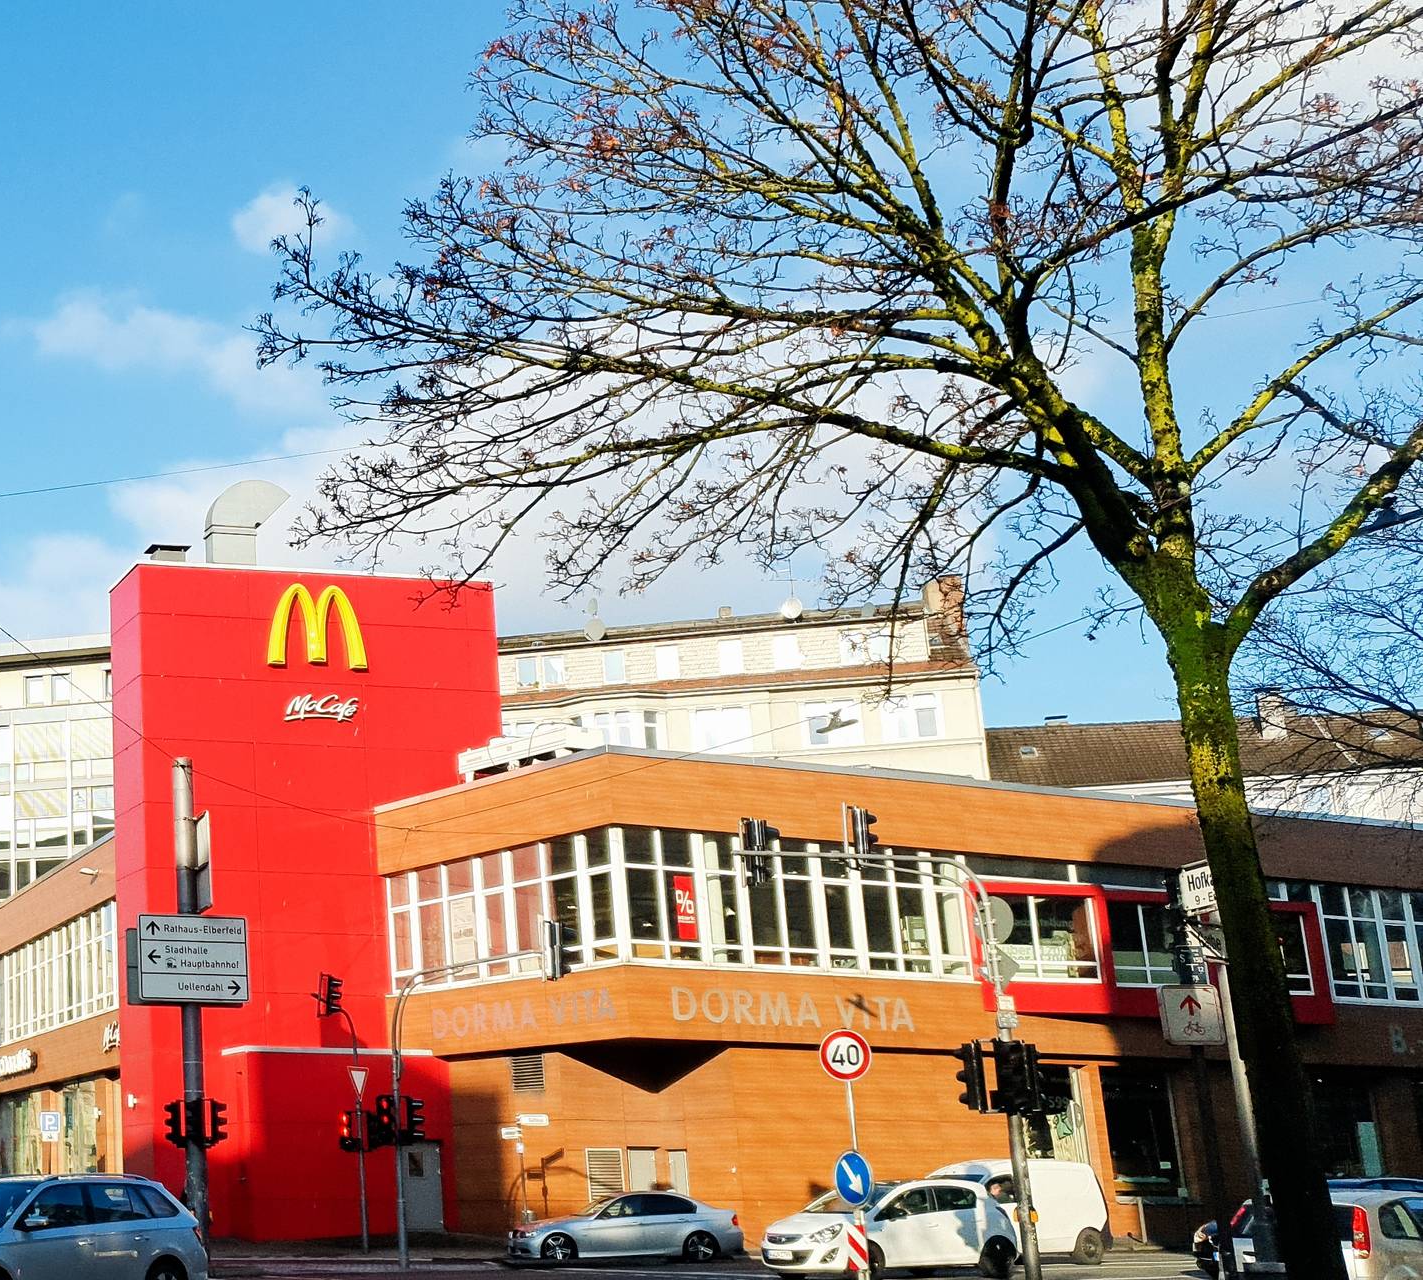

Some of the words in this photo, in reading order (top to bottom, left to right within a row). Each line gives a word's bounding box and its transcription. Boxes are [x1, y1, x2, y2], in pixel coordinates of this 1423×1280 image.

[163, 924, 242, 935] Rathaus-Elberfeld
[165, 945, 208, 955] Stadthalle
[180, 959, 239, 969] Hauptbahnhof
[178, 982, 224, 992] Uellendahl
[432, 1000, 540, 1040] DORMA
[548, 986, 618, 1026] VITA
[671, 986, 822, 1028] DORMA
[834, 994, 915, 1032] VITA
[831, 1044, 861, 1067] 40
